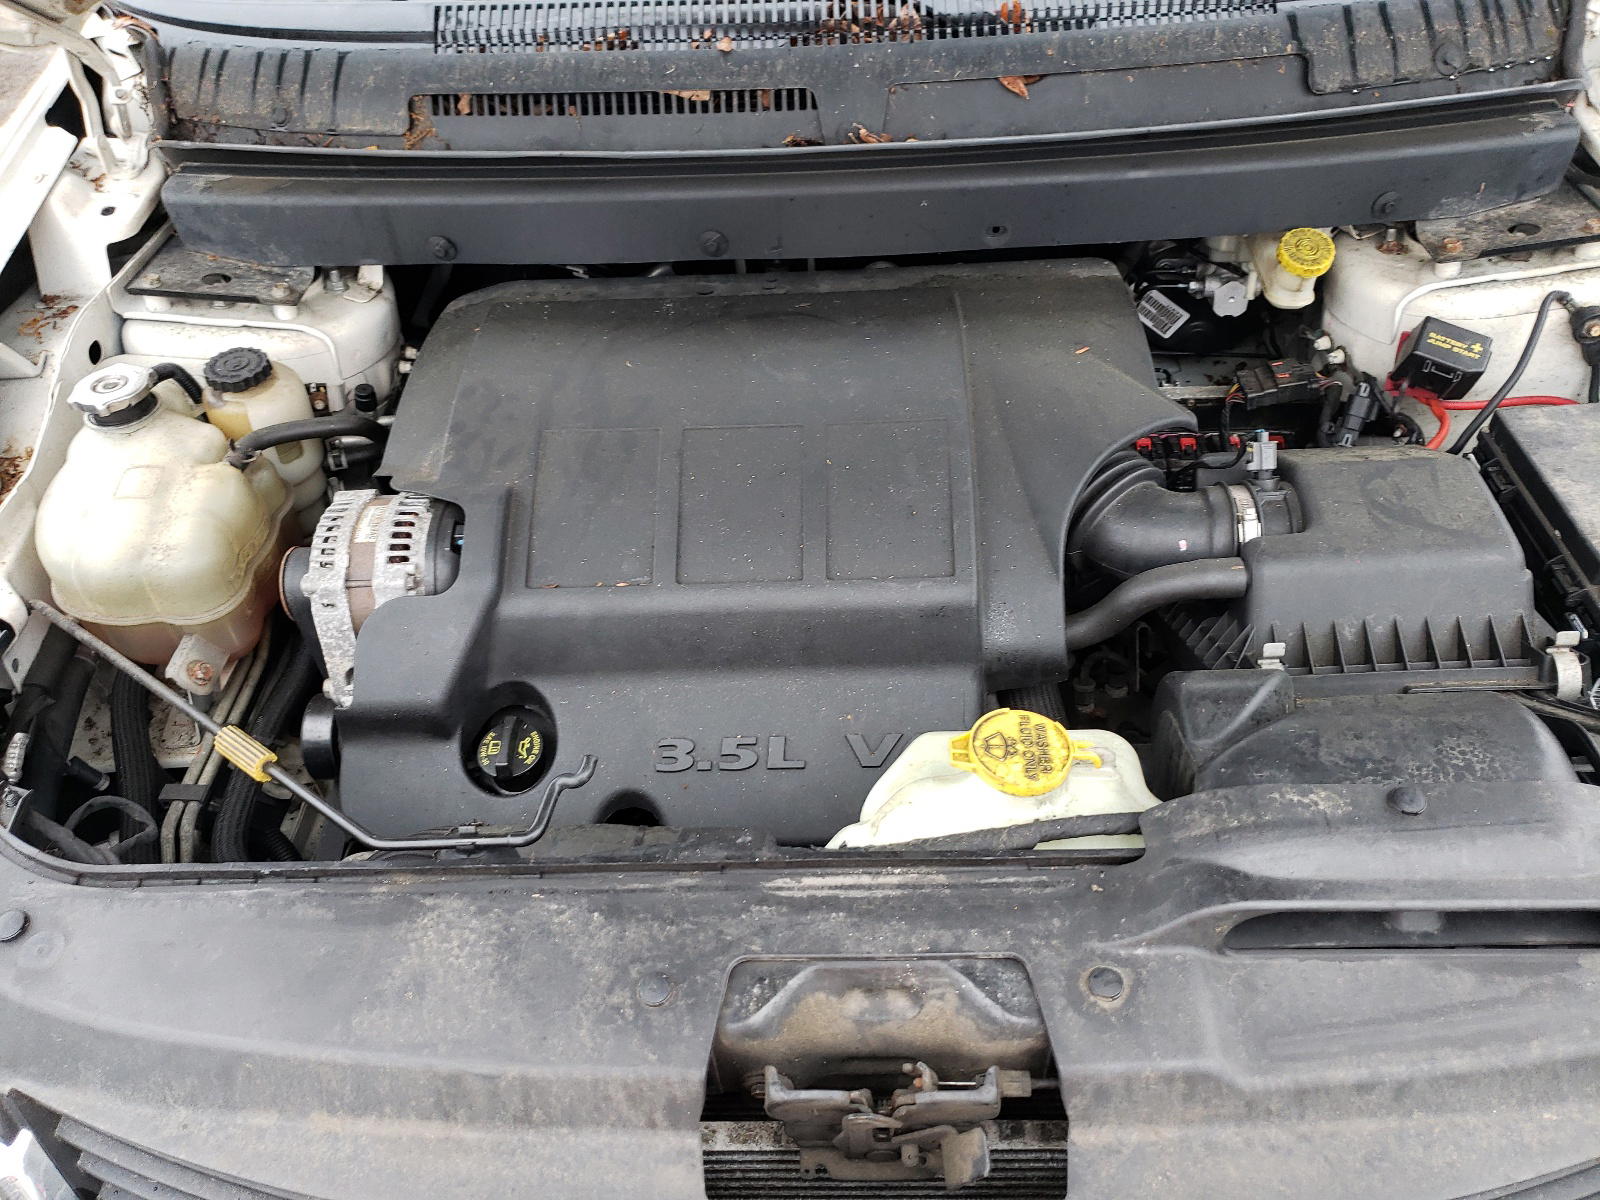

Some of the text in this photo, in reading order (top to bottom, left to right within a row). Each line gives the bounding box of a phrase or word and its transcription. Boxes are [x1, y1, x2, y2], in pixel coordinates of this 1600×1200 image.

[1426, 338, 1481, 360] JUMP START
[1428, 332, 1469, 348] BATTERY
[482, 731, 496, 744] SAE
[523, 730, 541, 765] ENGINE OIL
[655, 735, 807, 773] 3.5L
[1018, 714, 1040, 781] FLUID ONLY
[1034, 723, 1054, 774] WASHER
